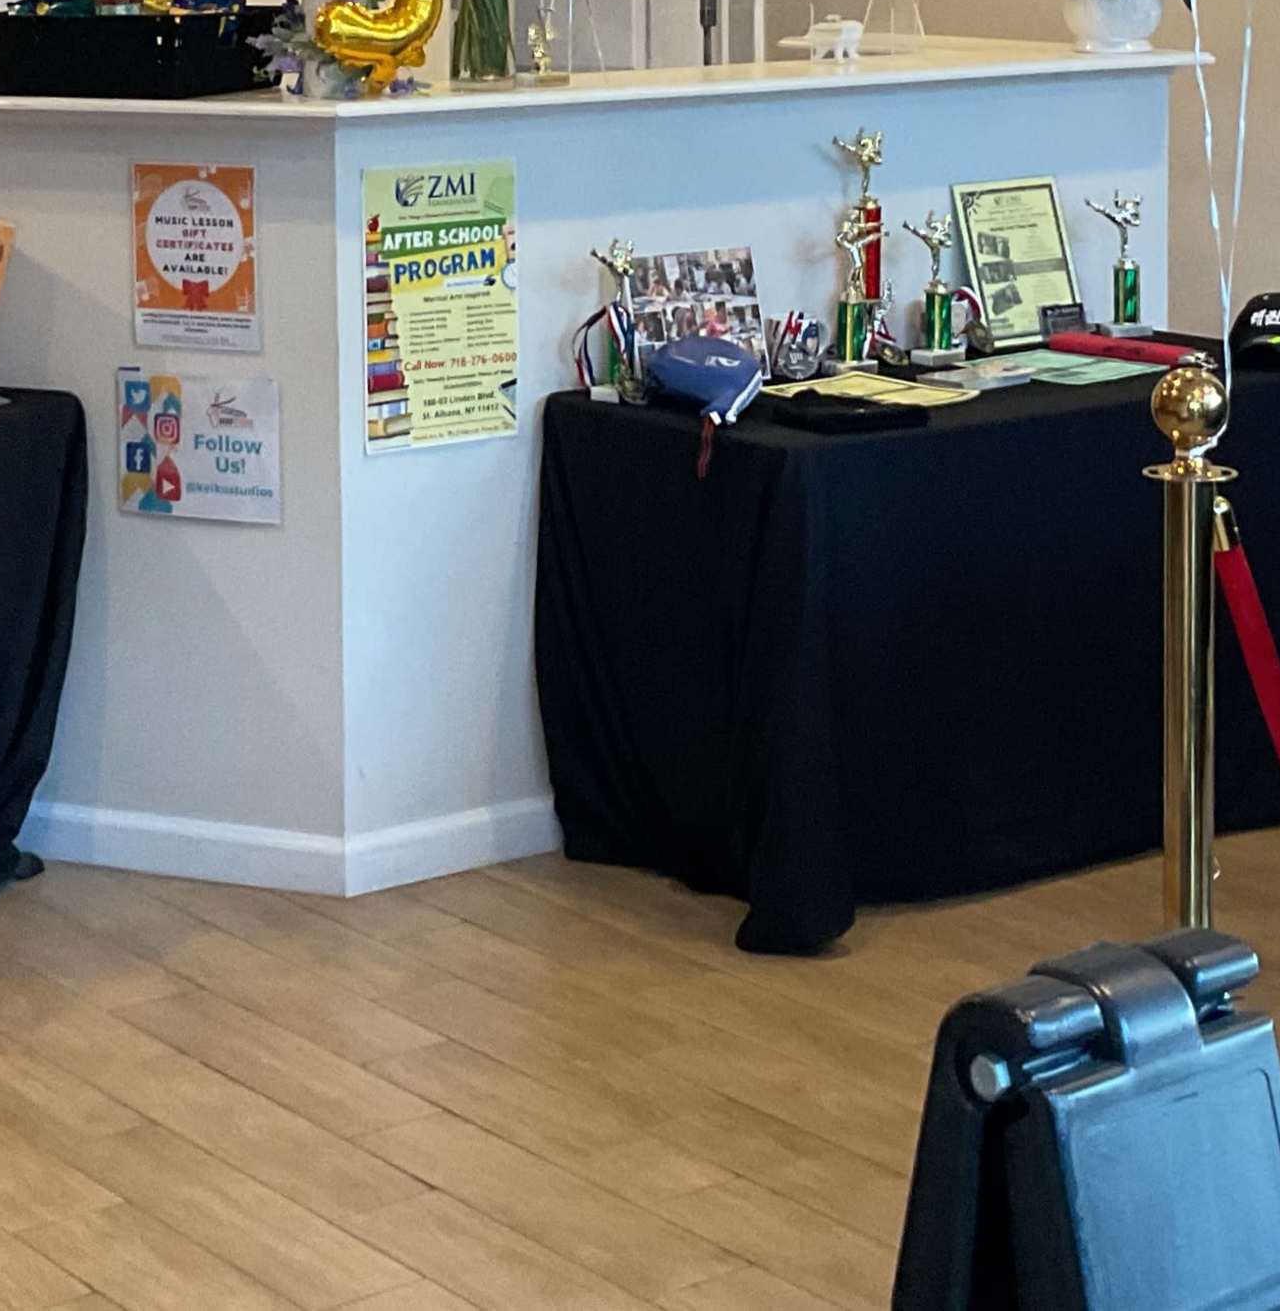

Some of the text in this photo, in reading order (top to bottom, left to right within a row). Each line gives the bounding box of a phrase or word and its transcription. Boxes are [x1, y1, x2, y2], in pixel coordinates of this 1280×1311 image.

[428, 172, 476, 199] ZMI
[154, 216, 234, 228] MUSIC LESSON
[182, 229, 207, 238] GIFT
[383, 224, 502, 251] AFTER SCHOOL
[156, 239, 234, 252] CERTIFICATES
[184, 253, 205, 262] ARE
[162, 264, 228, 275] AVAILABLE!
[394, 248, 495, 284] PROGRAM
[404, 360, 422, 371] Call
[449, 394, 476, 404] Linden
[465, 405, 476, 413] NY
[193, 434, 264, 455] Follow
[215, 456, 246, 475] Us!
